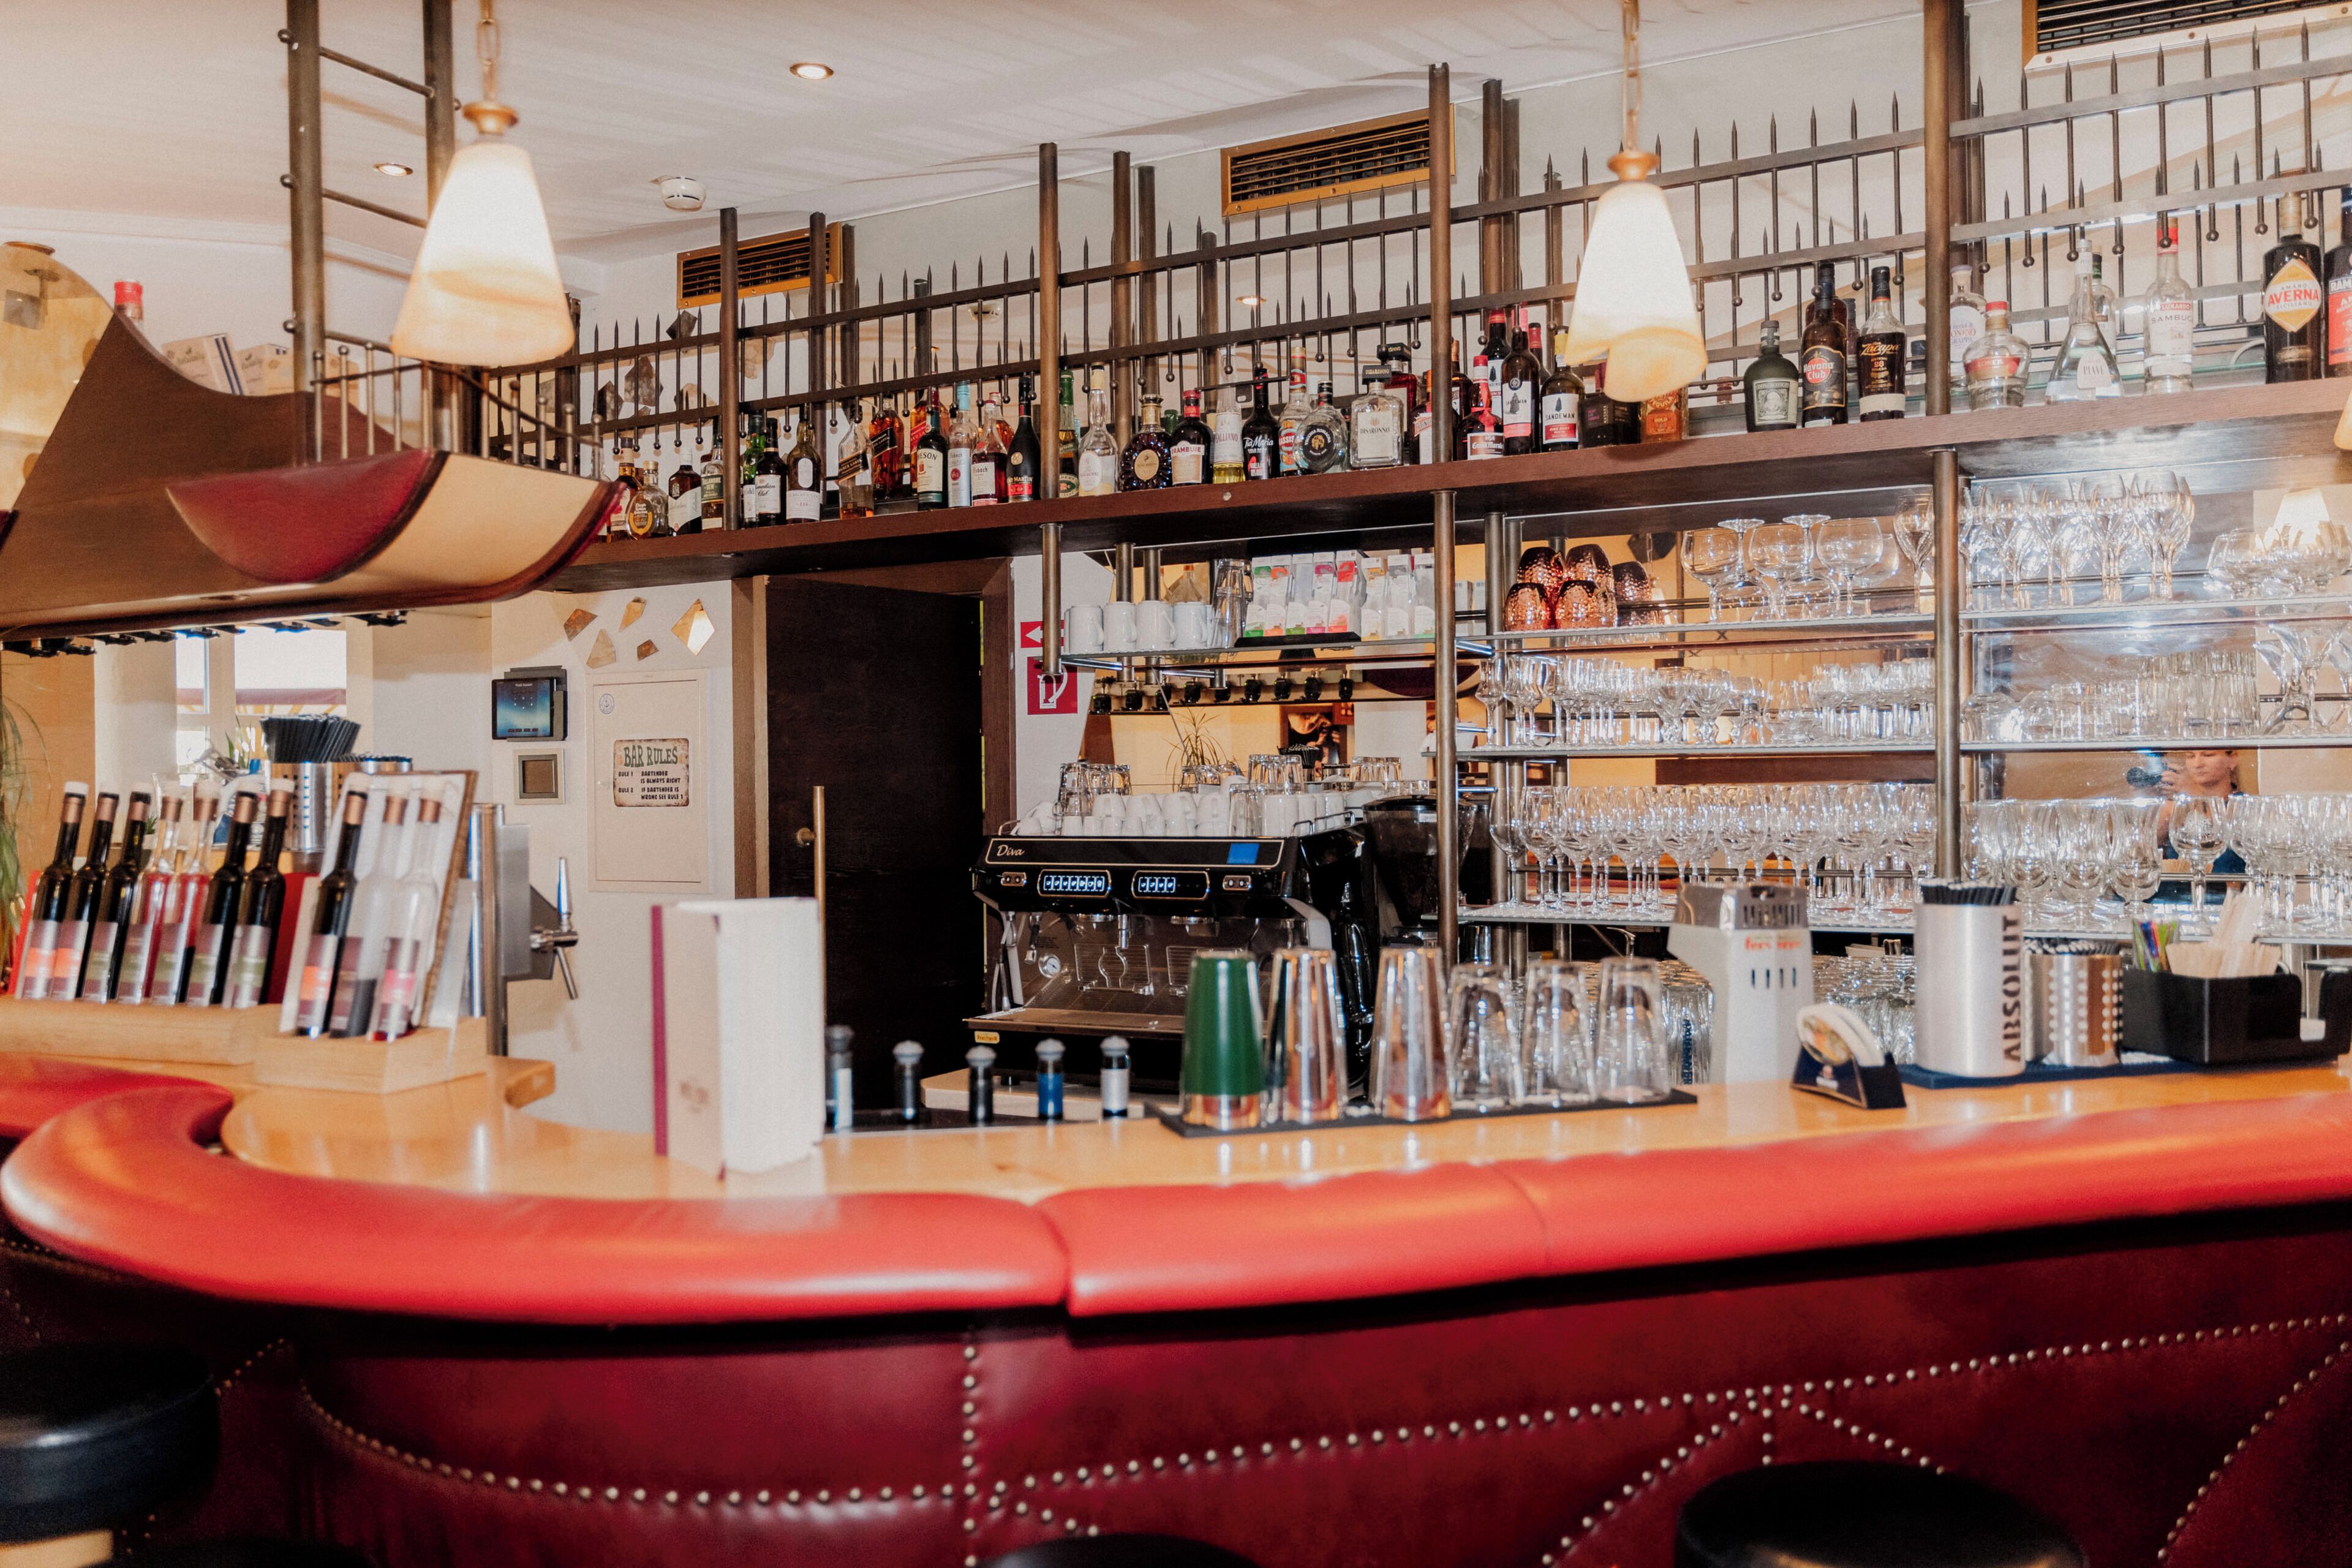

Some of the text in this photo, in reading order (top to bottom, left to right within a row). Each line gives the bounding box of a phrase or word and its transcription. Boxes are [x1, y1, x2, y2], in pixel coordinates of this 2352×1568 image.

[2267, 288, 2319, 306] AVERNA
[1860, 344, 1900, 356] Zacapa
[1803, 362, 1834, 373] Havana
[1807, 370, 1825, 380] Club
[1242, 435, 1274, 449] Tia Maria
[624, 745, 678, 767] BAR RULES
[997, 845, 1025, 856] Diva
[2002, 916, 2021, 1062] ABSOLUT
